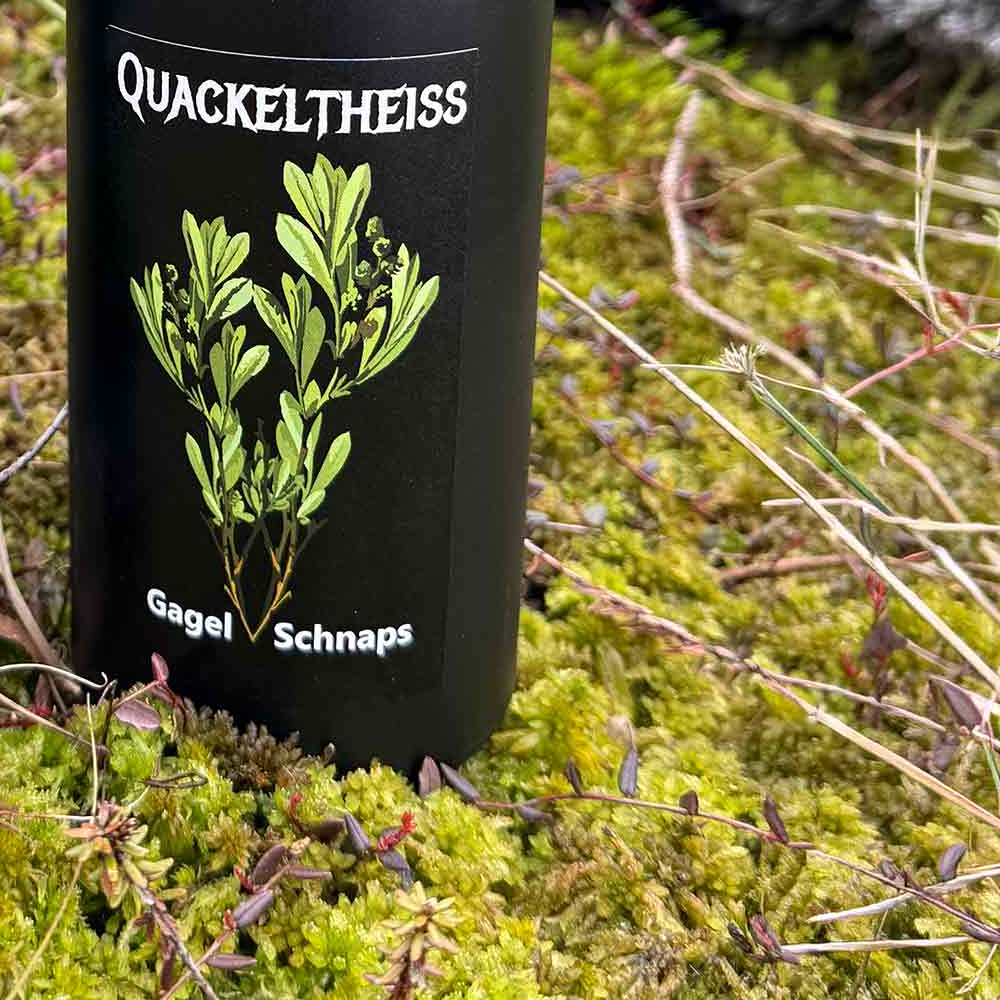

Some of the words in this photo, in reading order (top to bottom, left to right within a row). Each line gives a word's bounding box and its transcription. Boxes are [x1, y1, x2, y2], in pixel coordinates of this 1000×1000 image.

[117, 51, 468, 141] QUACKELTHEISS
[147, 588, 232, 641] Gagel
[273, 622, 415, 657] Schnaps
